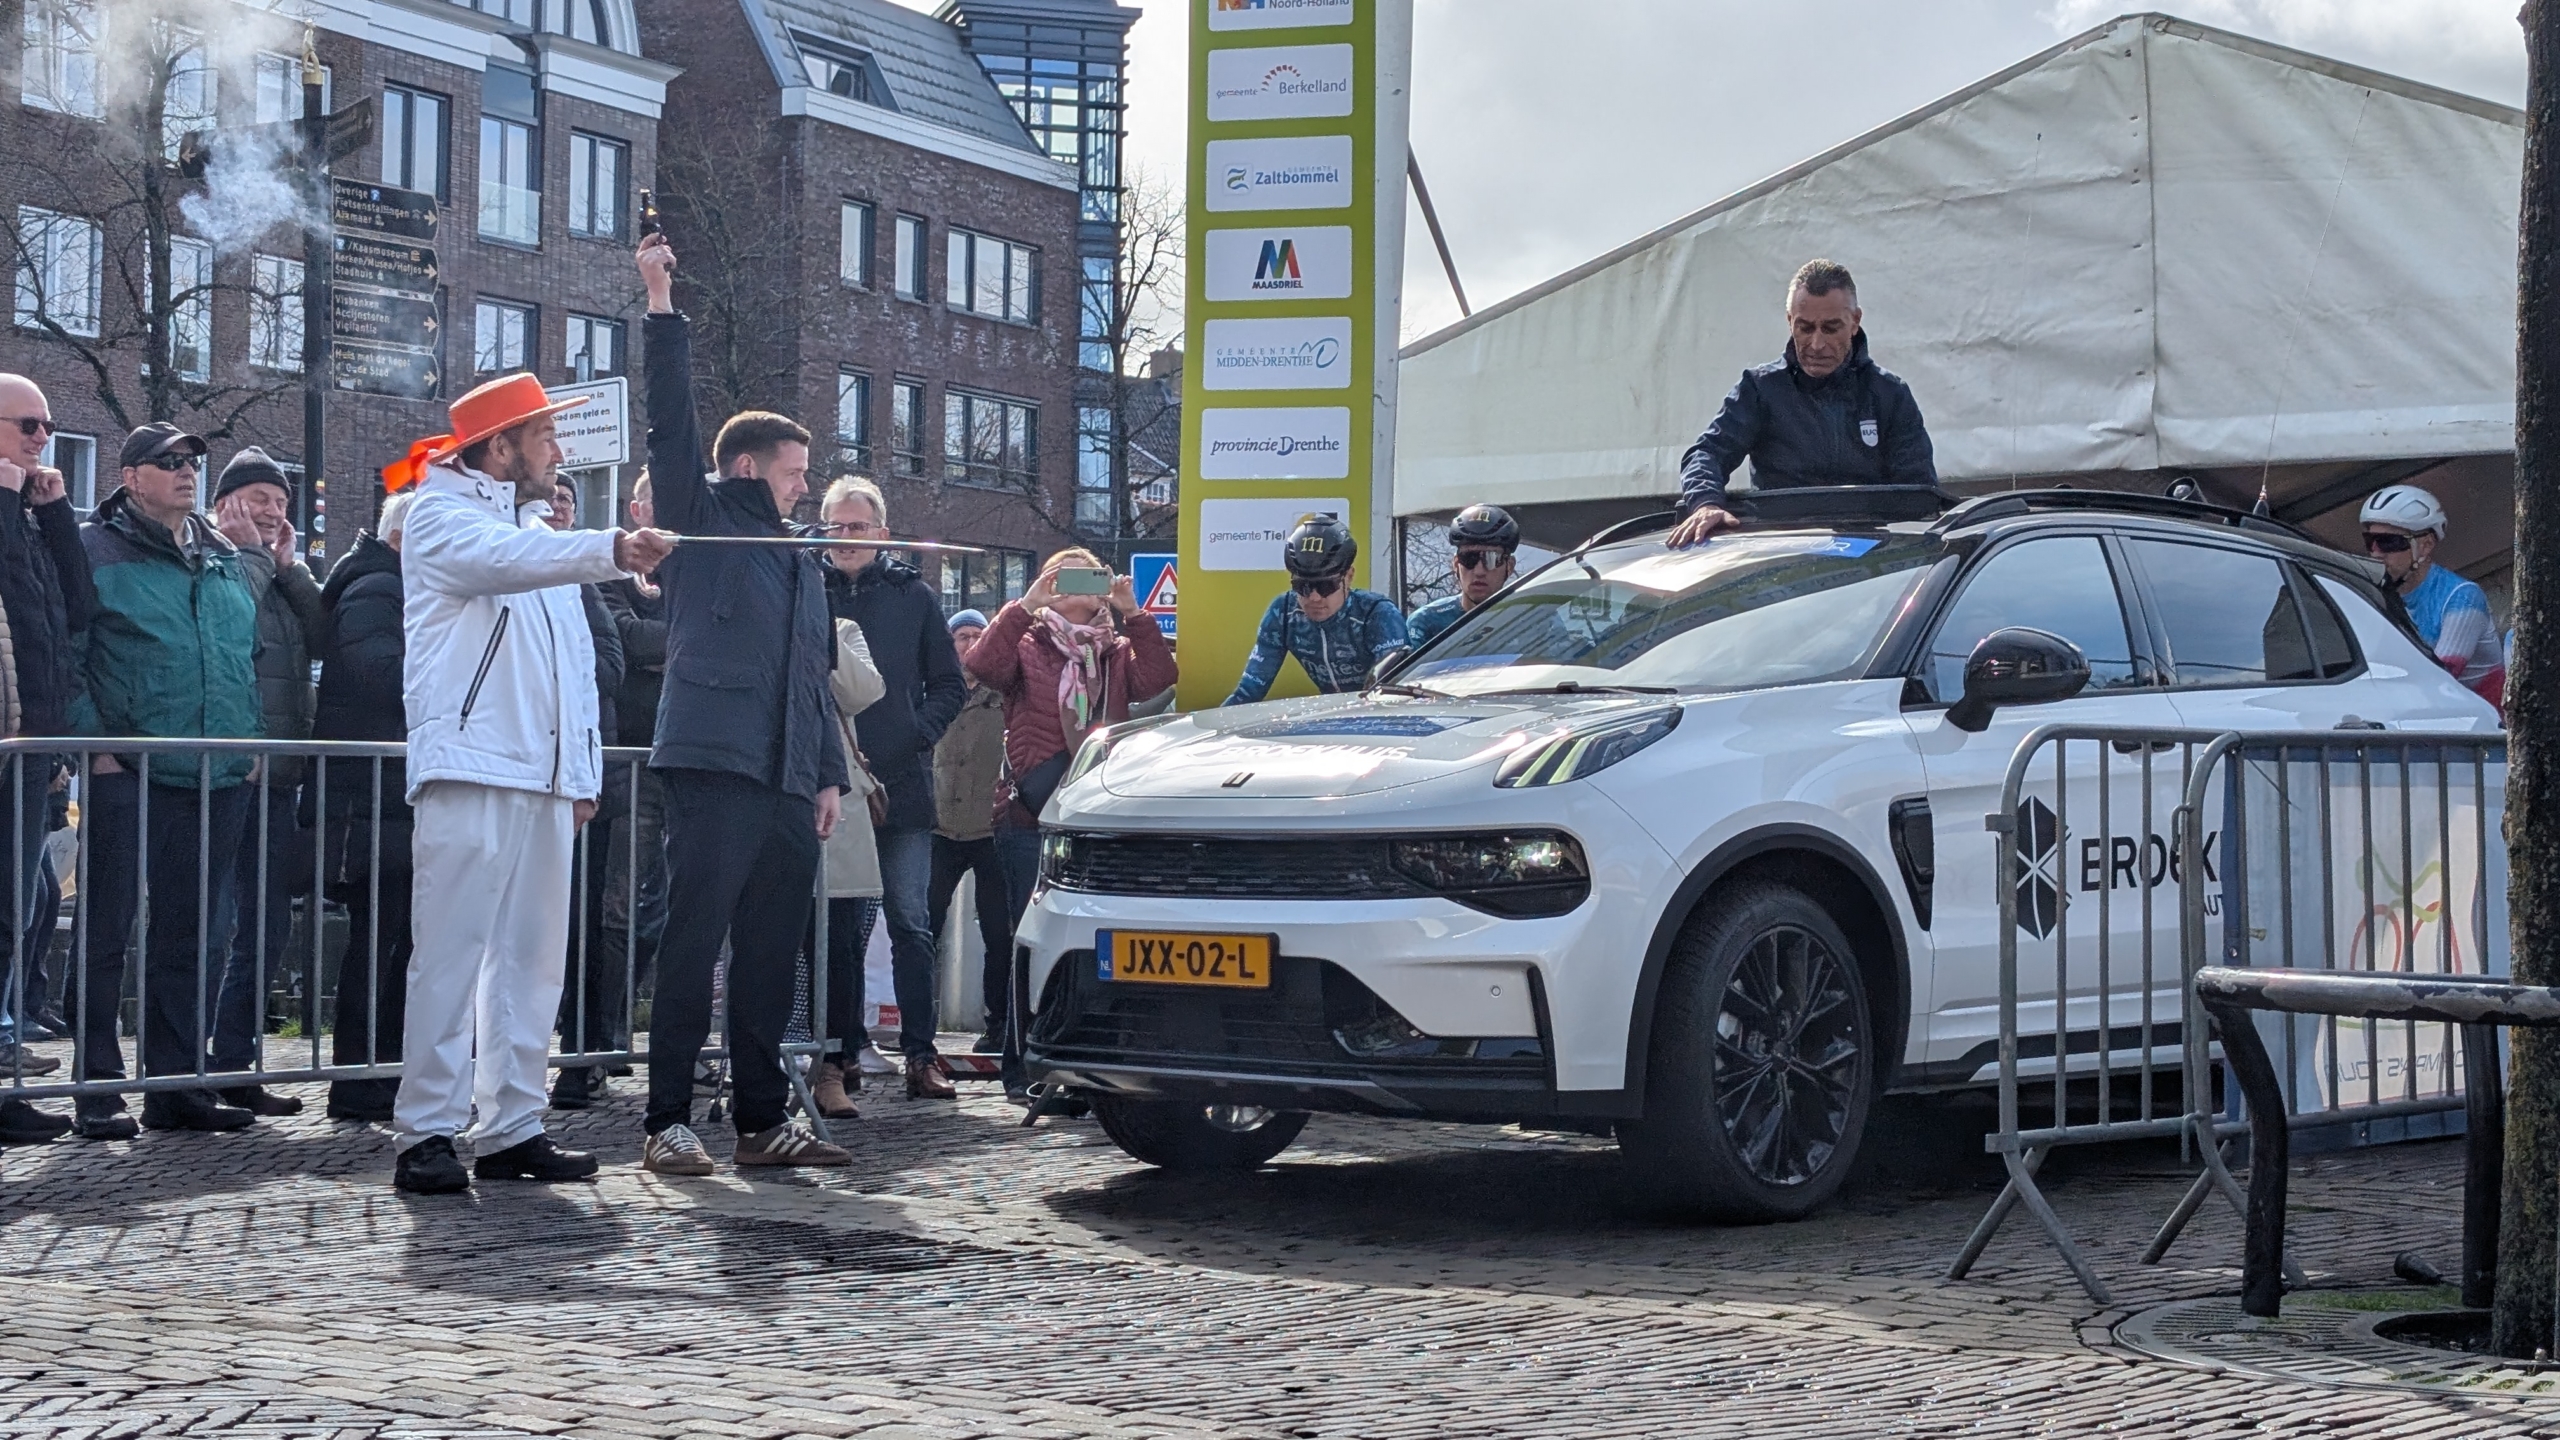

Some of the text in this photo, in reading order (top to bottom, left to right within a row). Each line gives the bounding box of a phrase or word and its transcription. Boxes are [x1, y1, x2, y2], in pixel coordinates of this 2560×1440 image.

[1269, 0, 1349, 9] Noord-Holland
[1279, 79, 1347, 94] Berkelland
[1216, 87, 1258, 99] gemeente
[1255, 168, 1339, 185] Zaltbommel
[335, 264, 374, 279] Stadhuis
[1252, 280, 1304, 289] MAASDRIEL
[1216, 347, 1296, 356] GEMEENTE
[1216, 356, 1313, 368] MIDDEN-DRENTHE
[1210, 436, 1340, 456] provincie Drenthe
[1210, 530, 1286, 543] gemeente Tiel
[1100, 959, 1111, 971] NL
[1123, 939, 1256, 979] JXX-02-L
